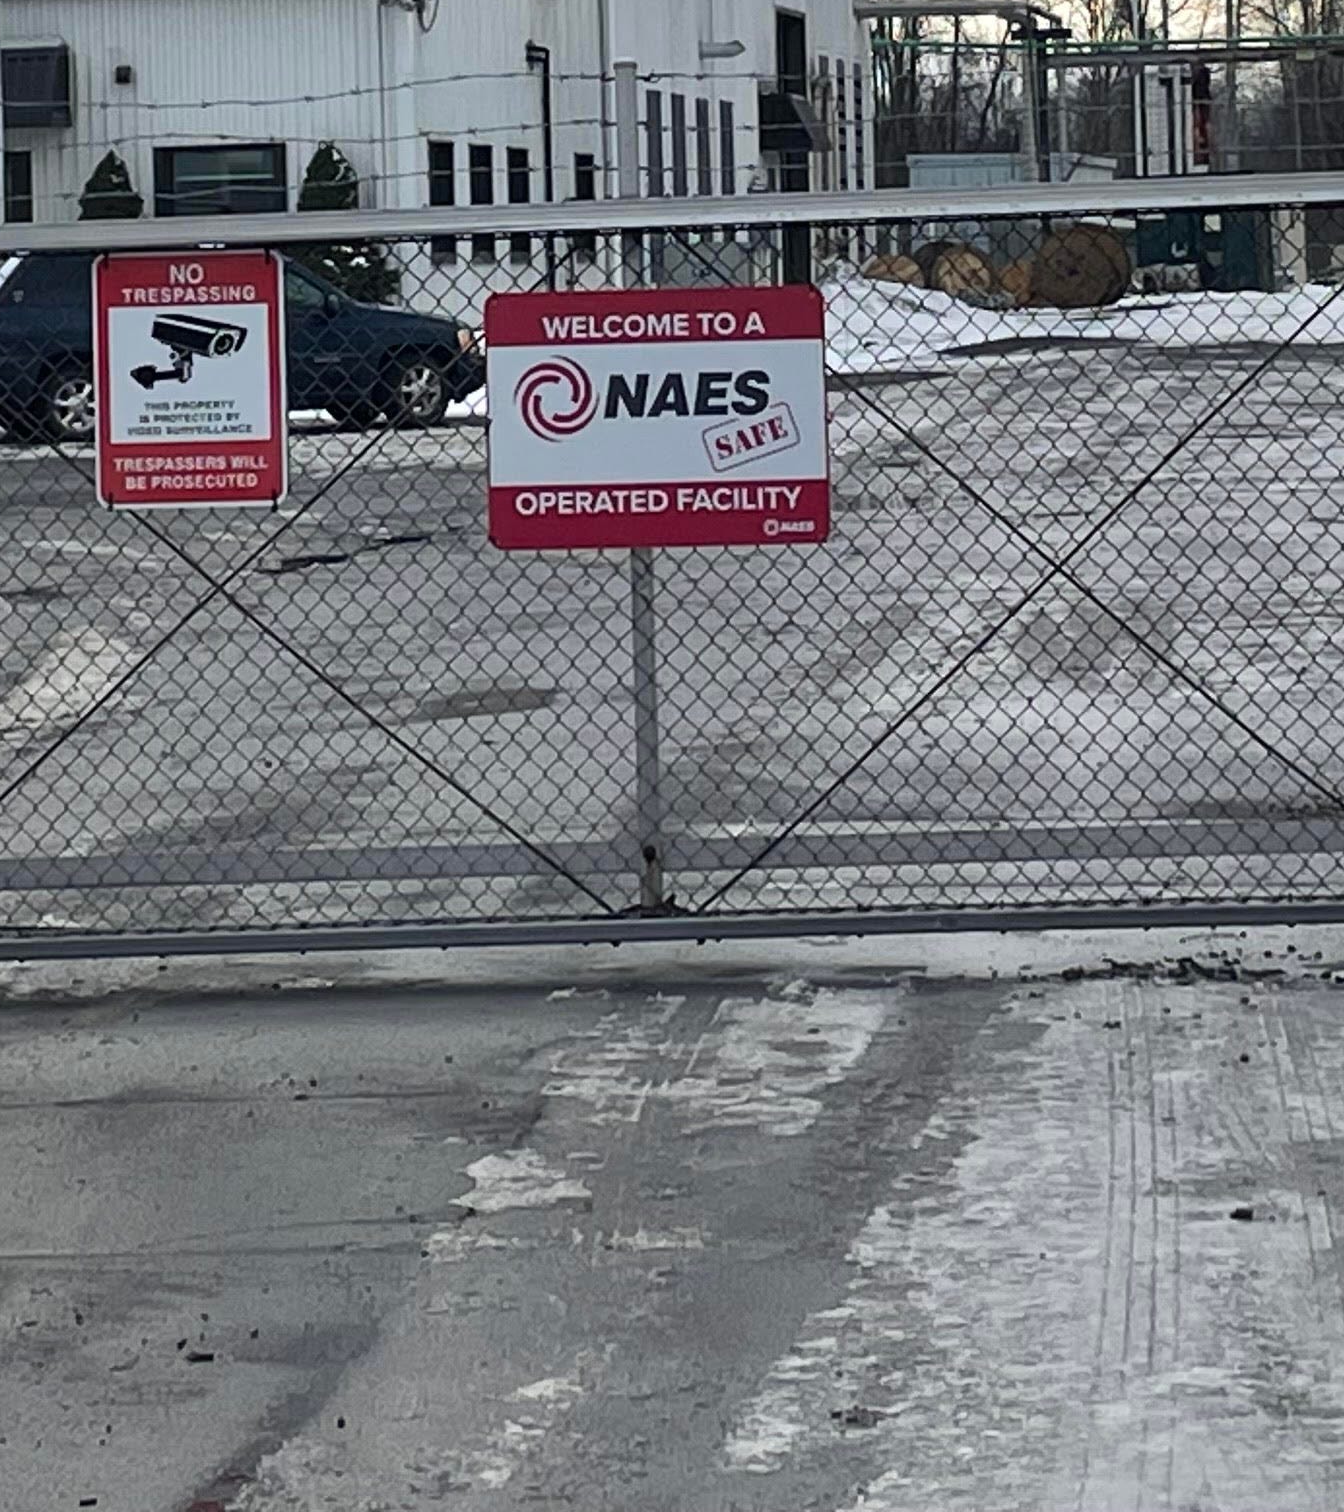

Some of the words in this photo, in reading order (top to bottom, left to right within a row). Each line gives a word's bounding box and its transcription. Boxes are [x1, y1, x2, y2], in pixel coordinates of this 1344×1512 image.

[169, 263, 204, 284] NO
[121, 285, 256, 303] TRESPASSING
[541, 313, 689, 339] WELCOME
[696, 312, 737, 335] TO
[743, 312, 766, 335] A
[603, 370, 771, 419] NAES
[174, 400, 235, 410] PROPERTY
[153, 413, 222, 423] PROTECTED
[226, 412, 240, 421] BY
[715, 416, 789, 461] SAFE
[113, 456, 227, 472] TRESPASSERS
[230, 455, 269, 470] WILL
[125, 476, 148, 491] BE
[150, 473, 258, 490] PROSECUTED
[515, 490, 669, 516] OPERATED
[676, 486, 802, 511] FACILITY
